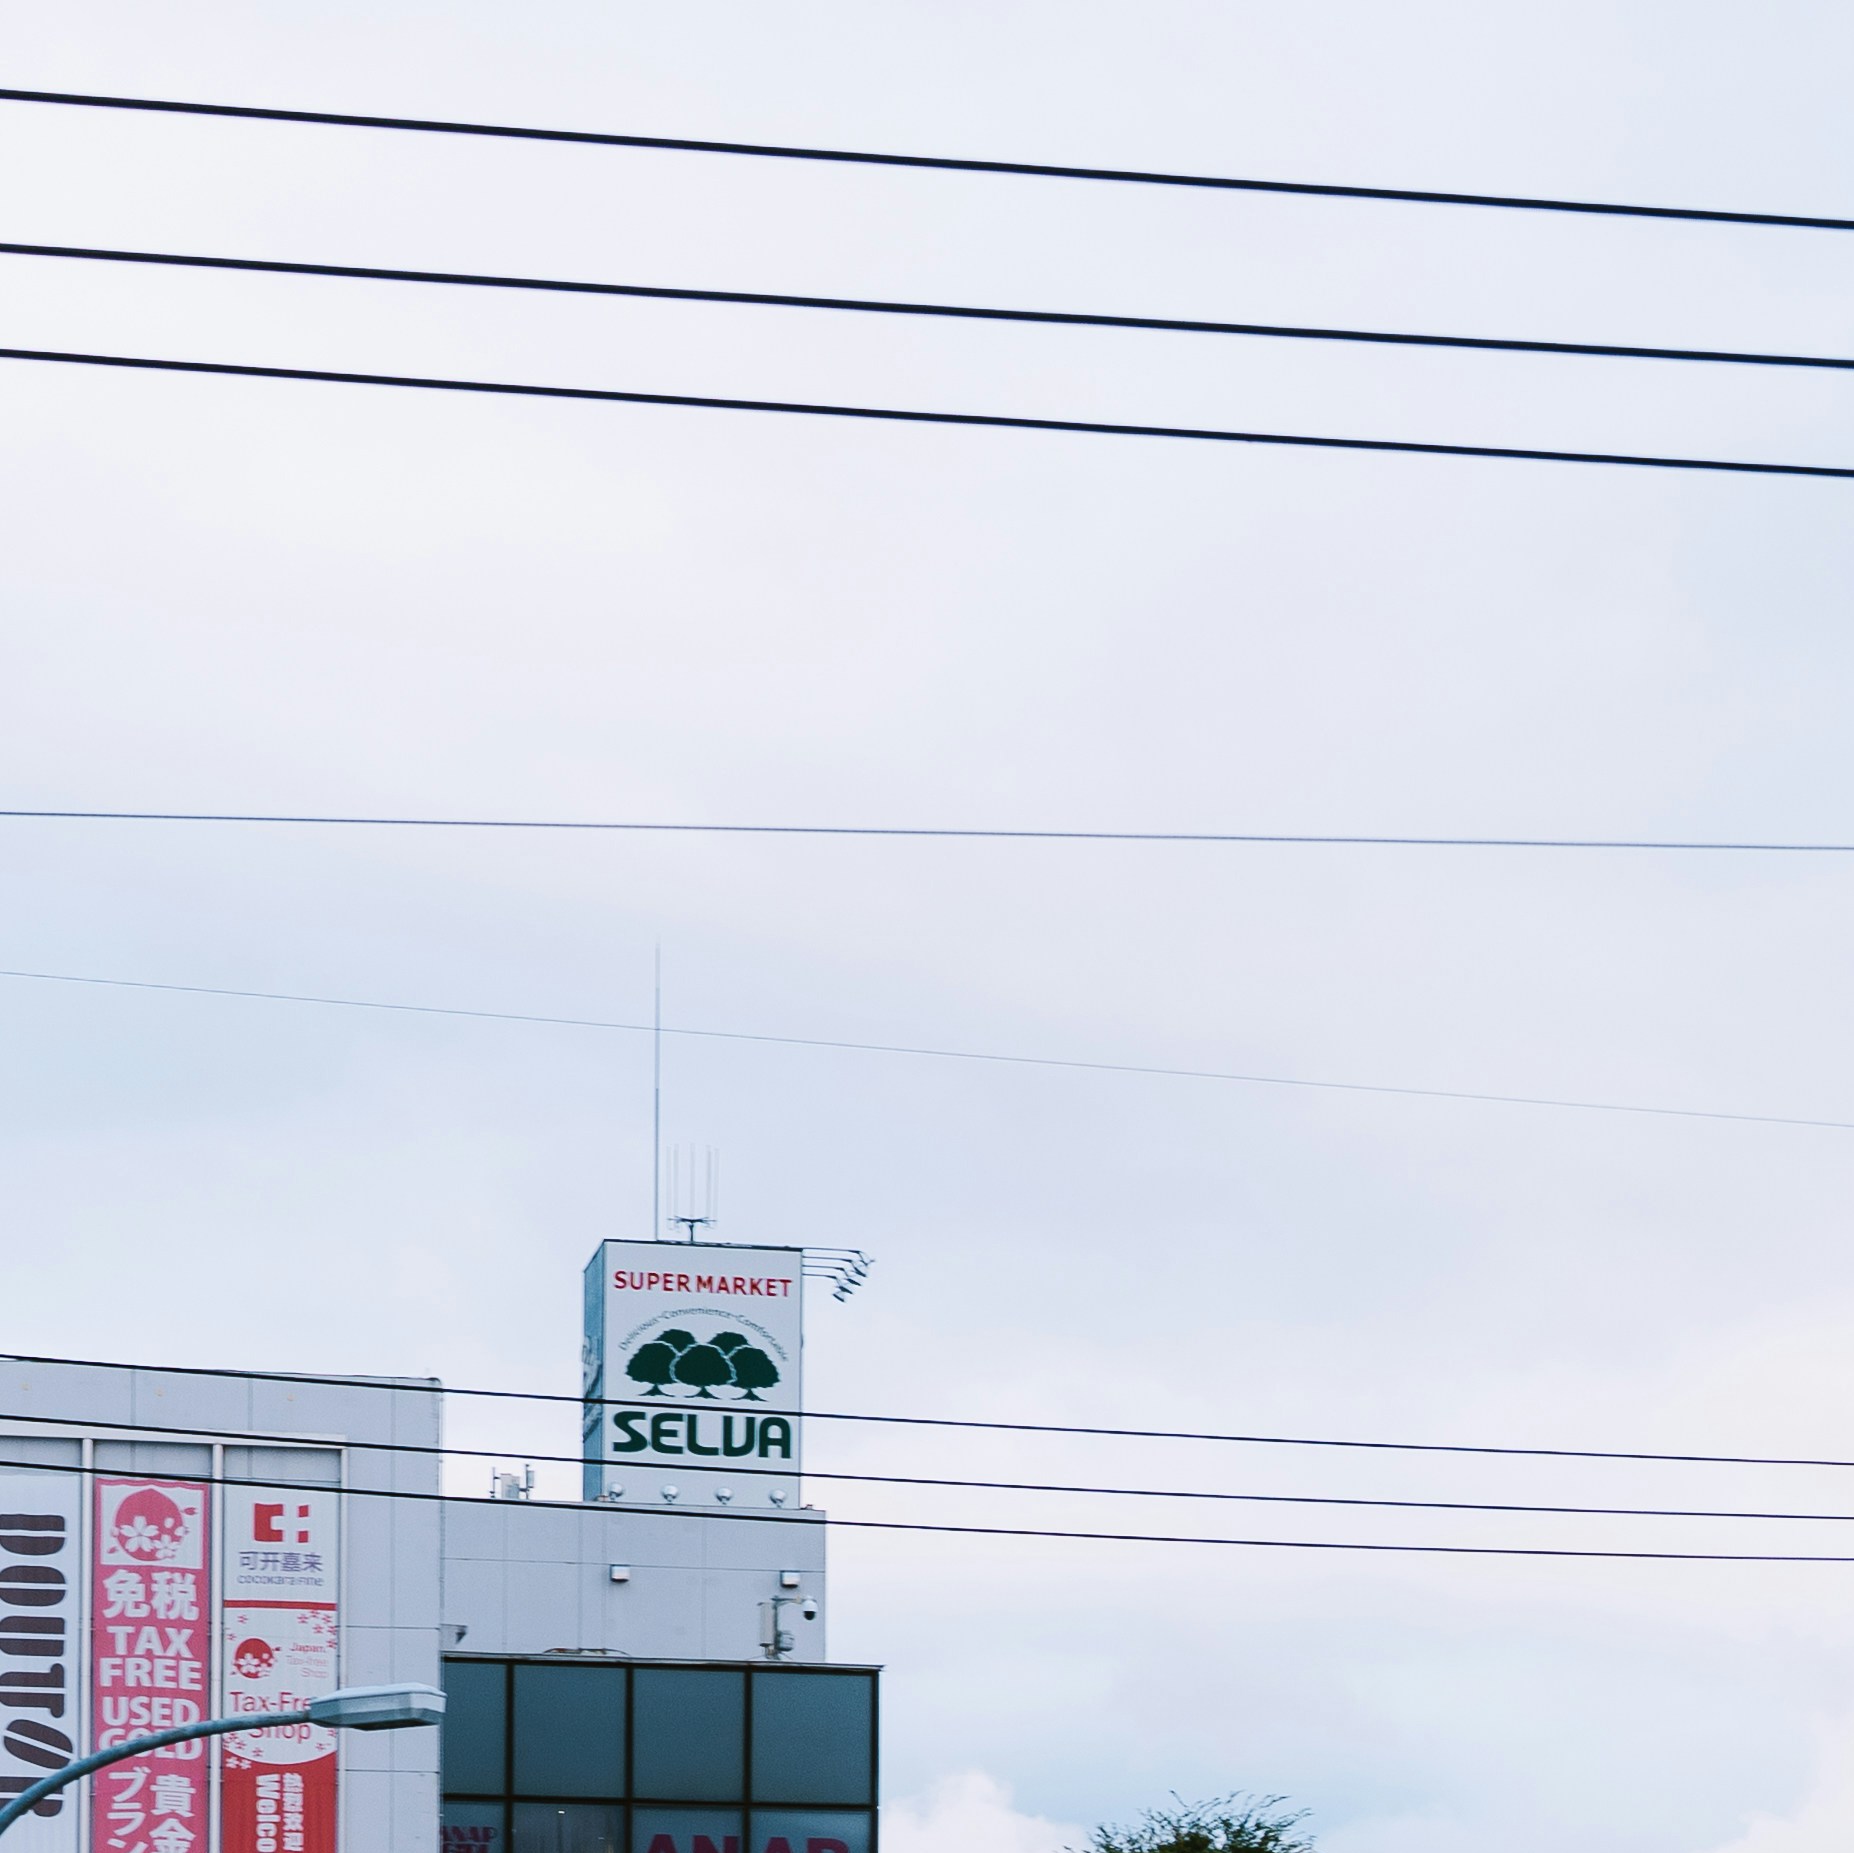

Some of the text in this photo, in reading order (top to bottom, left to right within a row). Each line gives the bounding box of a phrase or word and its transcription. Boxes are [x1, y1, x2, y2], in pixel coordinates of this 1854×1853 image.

[613, 1270, 793, 1298] SUPER MARKET
[612, 1410, 792, 1459] SELVA
[102, 1569, 201, 1623] 免税
[106, 1626, 195, 1658] TAX
[99, 1657, 203, 1691] FREE
[101, 1696, 201, 1728] USED
[229, 1691, 311, 1712] Tax-Fre
